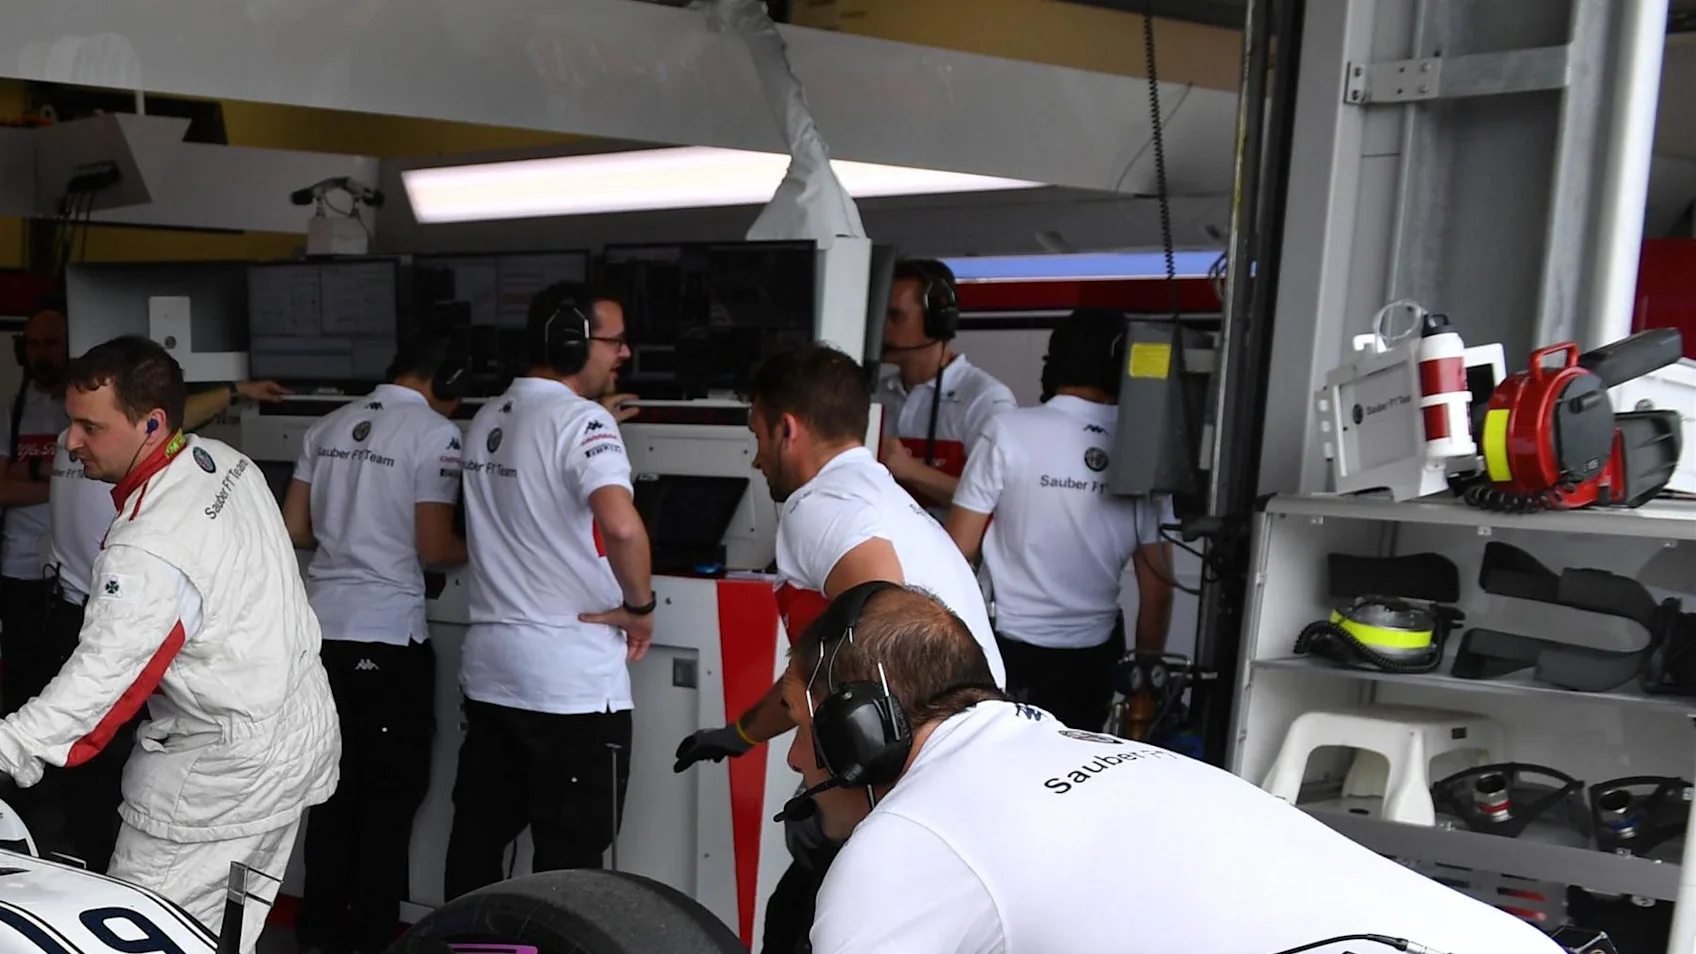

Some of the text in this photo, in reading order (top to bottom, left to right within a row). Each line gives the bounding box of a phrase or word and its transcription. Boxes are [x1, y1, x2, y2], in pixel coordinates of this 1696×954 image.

[364, 449, 396, 468] Team
[204, 486, 229, 520] Sauber
[228, 458, 249, 480] Team
[1039, 474, 1088, 492] Sauber
[1043, 750, 1148, 795] Sauber
